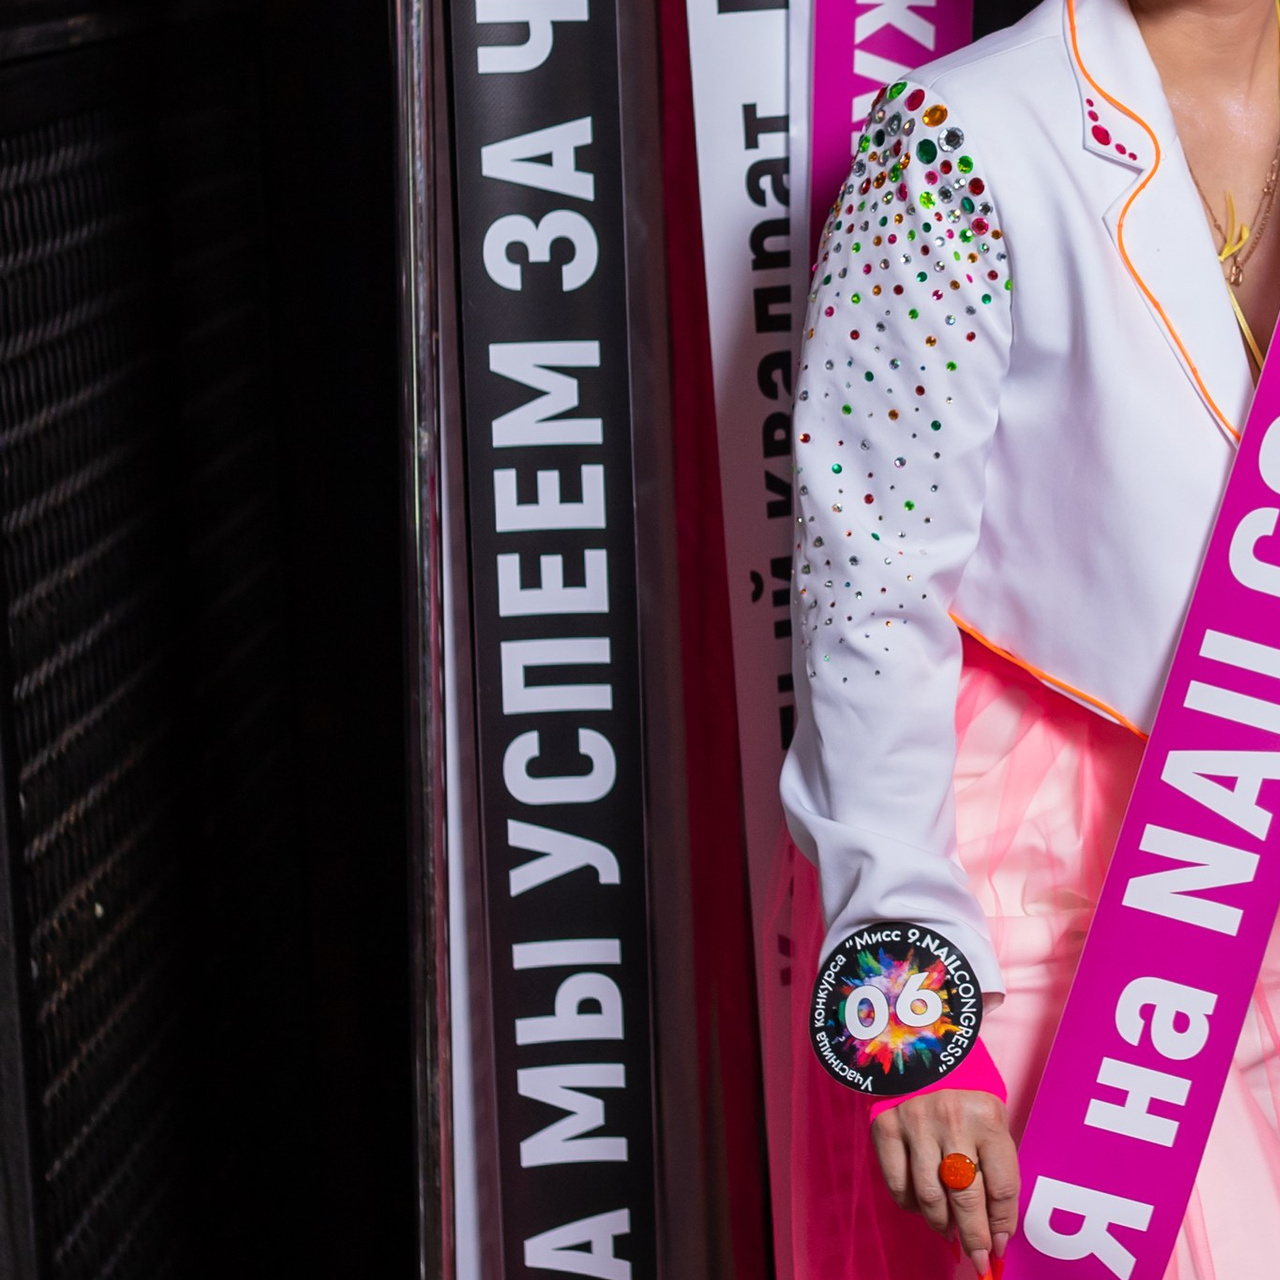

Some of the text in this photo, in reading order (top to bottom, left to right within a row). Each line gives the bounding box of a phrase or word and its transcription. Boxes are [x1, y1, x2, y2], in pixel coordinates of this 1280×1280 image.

[481, 115, 600, 292] ЗА
[490, 339, 621, 898] УСПЕЕМ
[512, 938, 629, 1168] МЫ
[814, 954, 847, 1027] конкурса
[815, 1030, 874, 1092] Участница
[844, 972, 943, 1040] 06
[1083, 976, 1219, 1148] на
